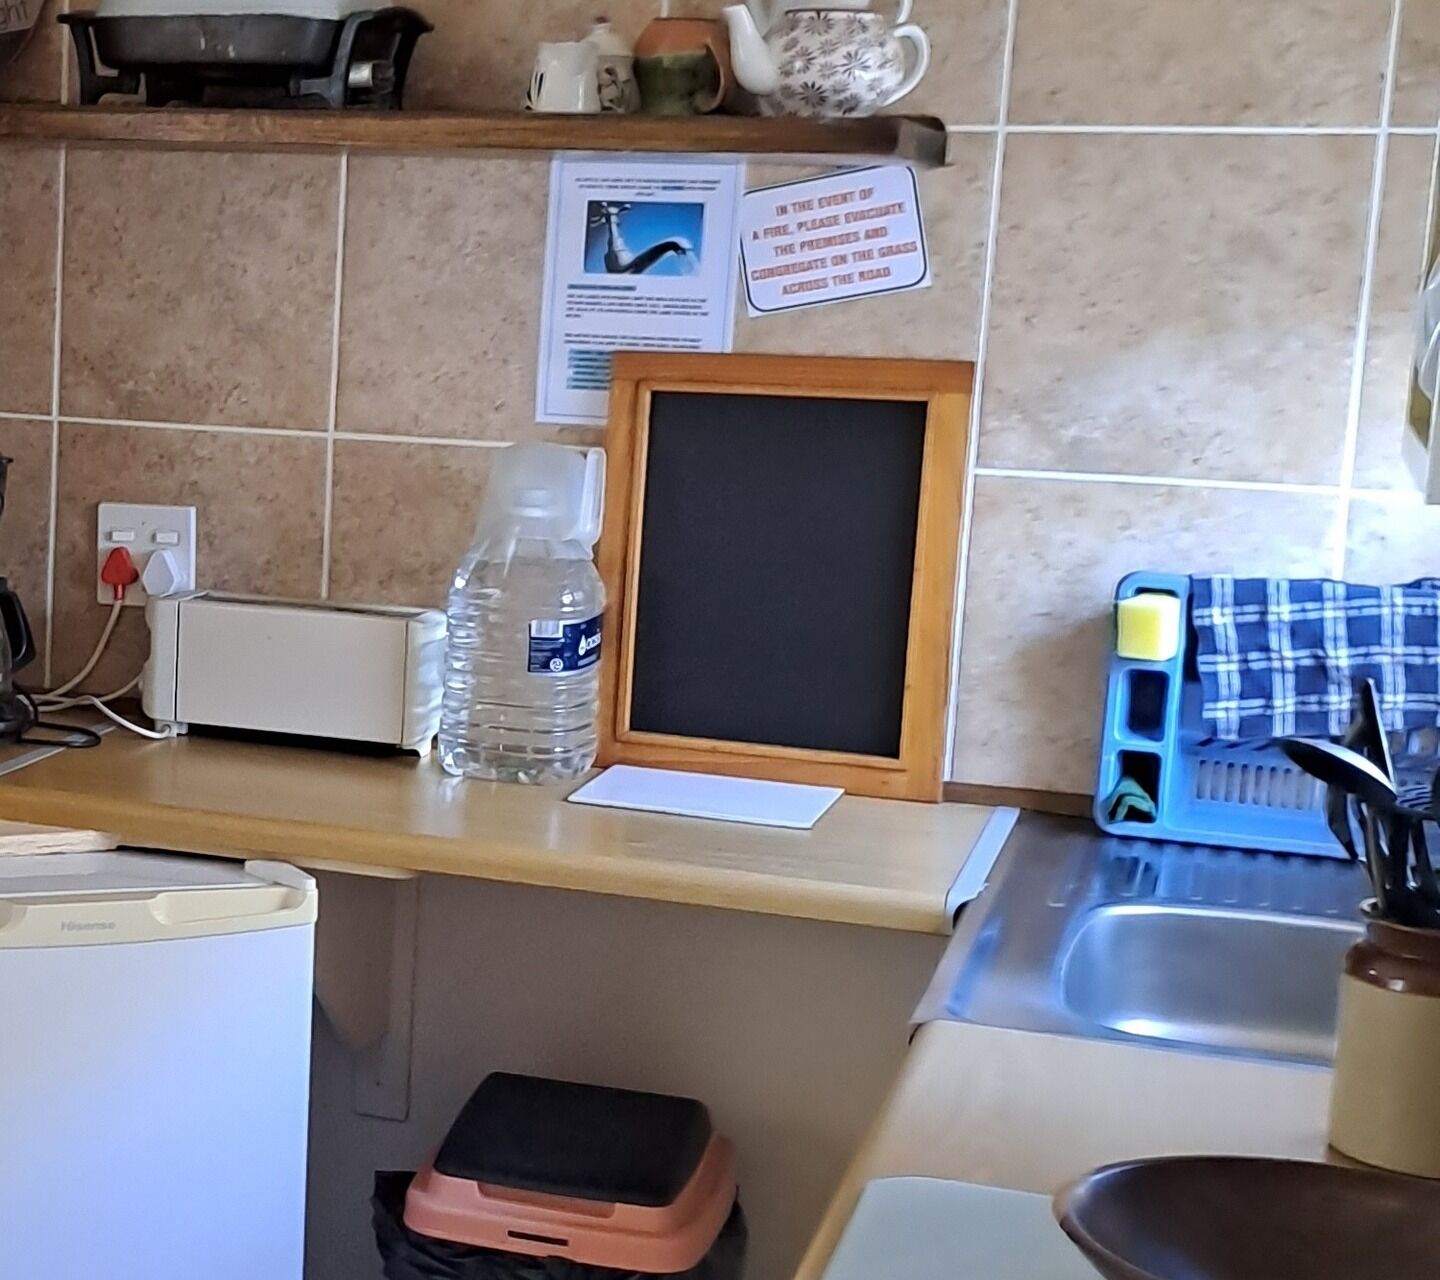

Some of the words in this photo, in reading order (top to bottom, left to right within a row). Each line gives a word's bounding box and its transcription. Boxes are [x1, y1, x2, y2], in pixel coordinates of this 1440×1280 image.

[776, 205, 788, 217] IN
[791, 199, 814, 216] THE
[818, 191, 856, 209] EVENT
[859, 187, 875, 201] OF
[752, 230, 759, 241] A
[797, 214, 840, 232] PLEASE
[844, 202, 904, 224] EVACUATE
[773, 243, 796, 257] THE
[800, 231, 859, 251] PREMISES
[864, 226, 888, 241] AND
[751, 257, 828, 281] CONGREGATE
[831, 254, 848, 267] ON
[851, 248, 874, 262] THE
[878, 241, 918, 258] GRASS
[782, 277, 829, 296] ACROSS
[832, 272, 855, 287] THE
[858, 266, 891, 283] ROAD
